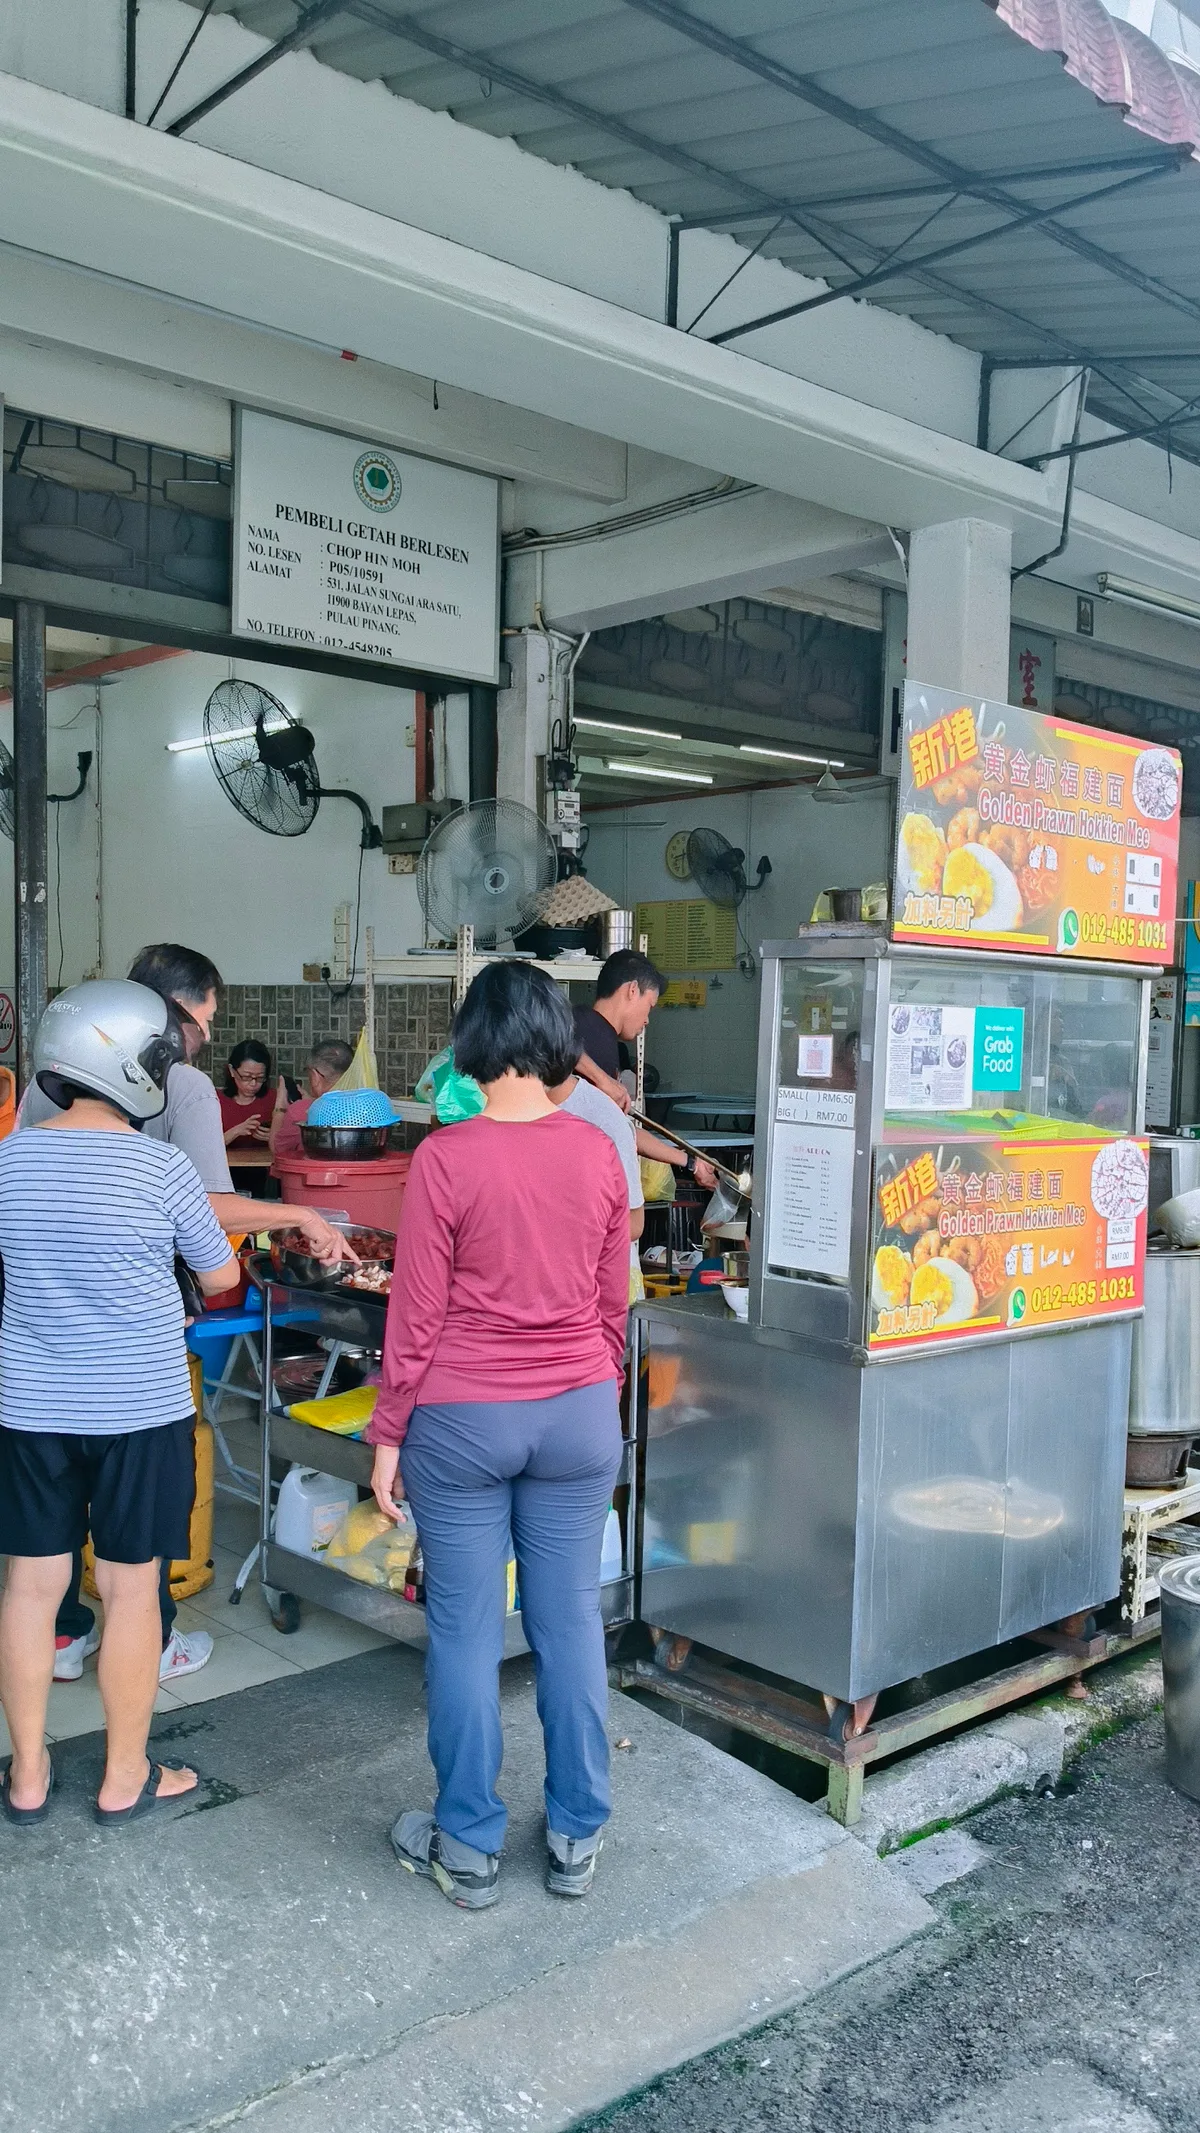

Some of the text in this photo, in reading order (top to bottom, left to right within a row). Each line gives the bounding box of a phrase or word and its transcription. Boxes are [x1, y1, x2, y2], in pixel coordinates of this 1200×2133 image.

[247, 524, 280, 542] NAMA
[327, 542, 362, 560] CHOP
[364, 550, 389, 566] HIN
[391, 557, 421, 574] MOH
[275, 503, 470, 565] PEMBELI GETAH BERLESEN
[247, 541, 266, 556] NO.
[268, 546, 302, 564] LESEN
[329, 560, 384, 583] P05/10591
[246, 561, 293, 579] ALAMAT
[327, 577, 344, 592] 531,
[345, 580, 377, 599] JALAN
[379, 588, 415, 606] SUNGAI
[415, 596, 436, 611] ARA
[436, 601, 462, 619] SATU,
[326, 610, 360, 628] PULAU
[362, 618, 401, 636] PINANG.
[327, 593, 417, 625] 11900 BAYAN LEPAS,
[246, 618, 265, 633] NO.
[267, 623, 316, 643] TELEFON
[909, 707, 979, 789] 新港
[983, 742, 1126, 809] 黄金虾福建面
[978, 788, 1150, 849] Golden Prawn Hokkien Mee
[1081, 913, 1167, 949] 012-485 1031
[984, 1035, 1014, 1054] Grab
[982, 1054, 1014, 1072] Food
[777, 1108, 791, 1117] BIG
[816, 1111, 848, 1122] RM7.00
[778, 1089, 804, 1100] SMALL
[822, 1092, 854, 1105] RM6.50
[880, 1151, 940, 1229] 新港
[941, 1169, 1064, 1206] 黄金虾福建面
[938, 1204, 1087, 1239] Golden Prawn Hokkien Mee
[1112, 1226, 1130, 1235] RM6.50
[1111, 1251, 1130, 1261] RM7.00
[1031, 1275, 1137, 1314] 012-485 1031
